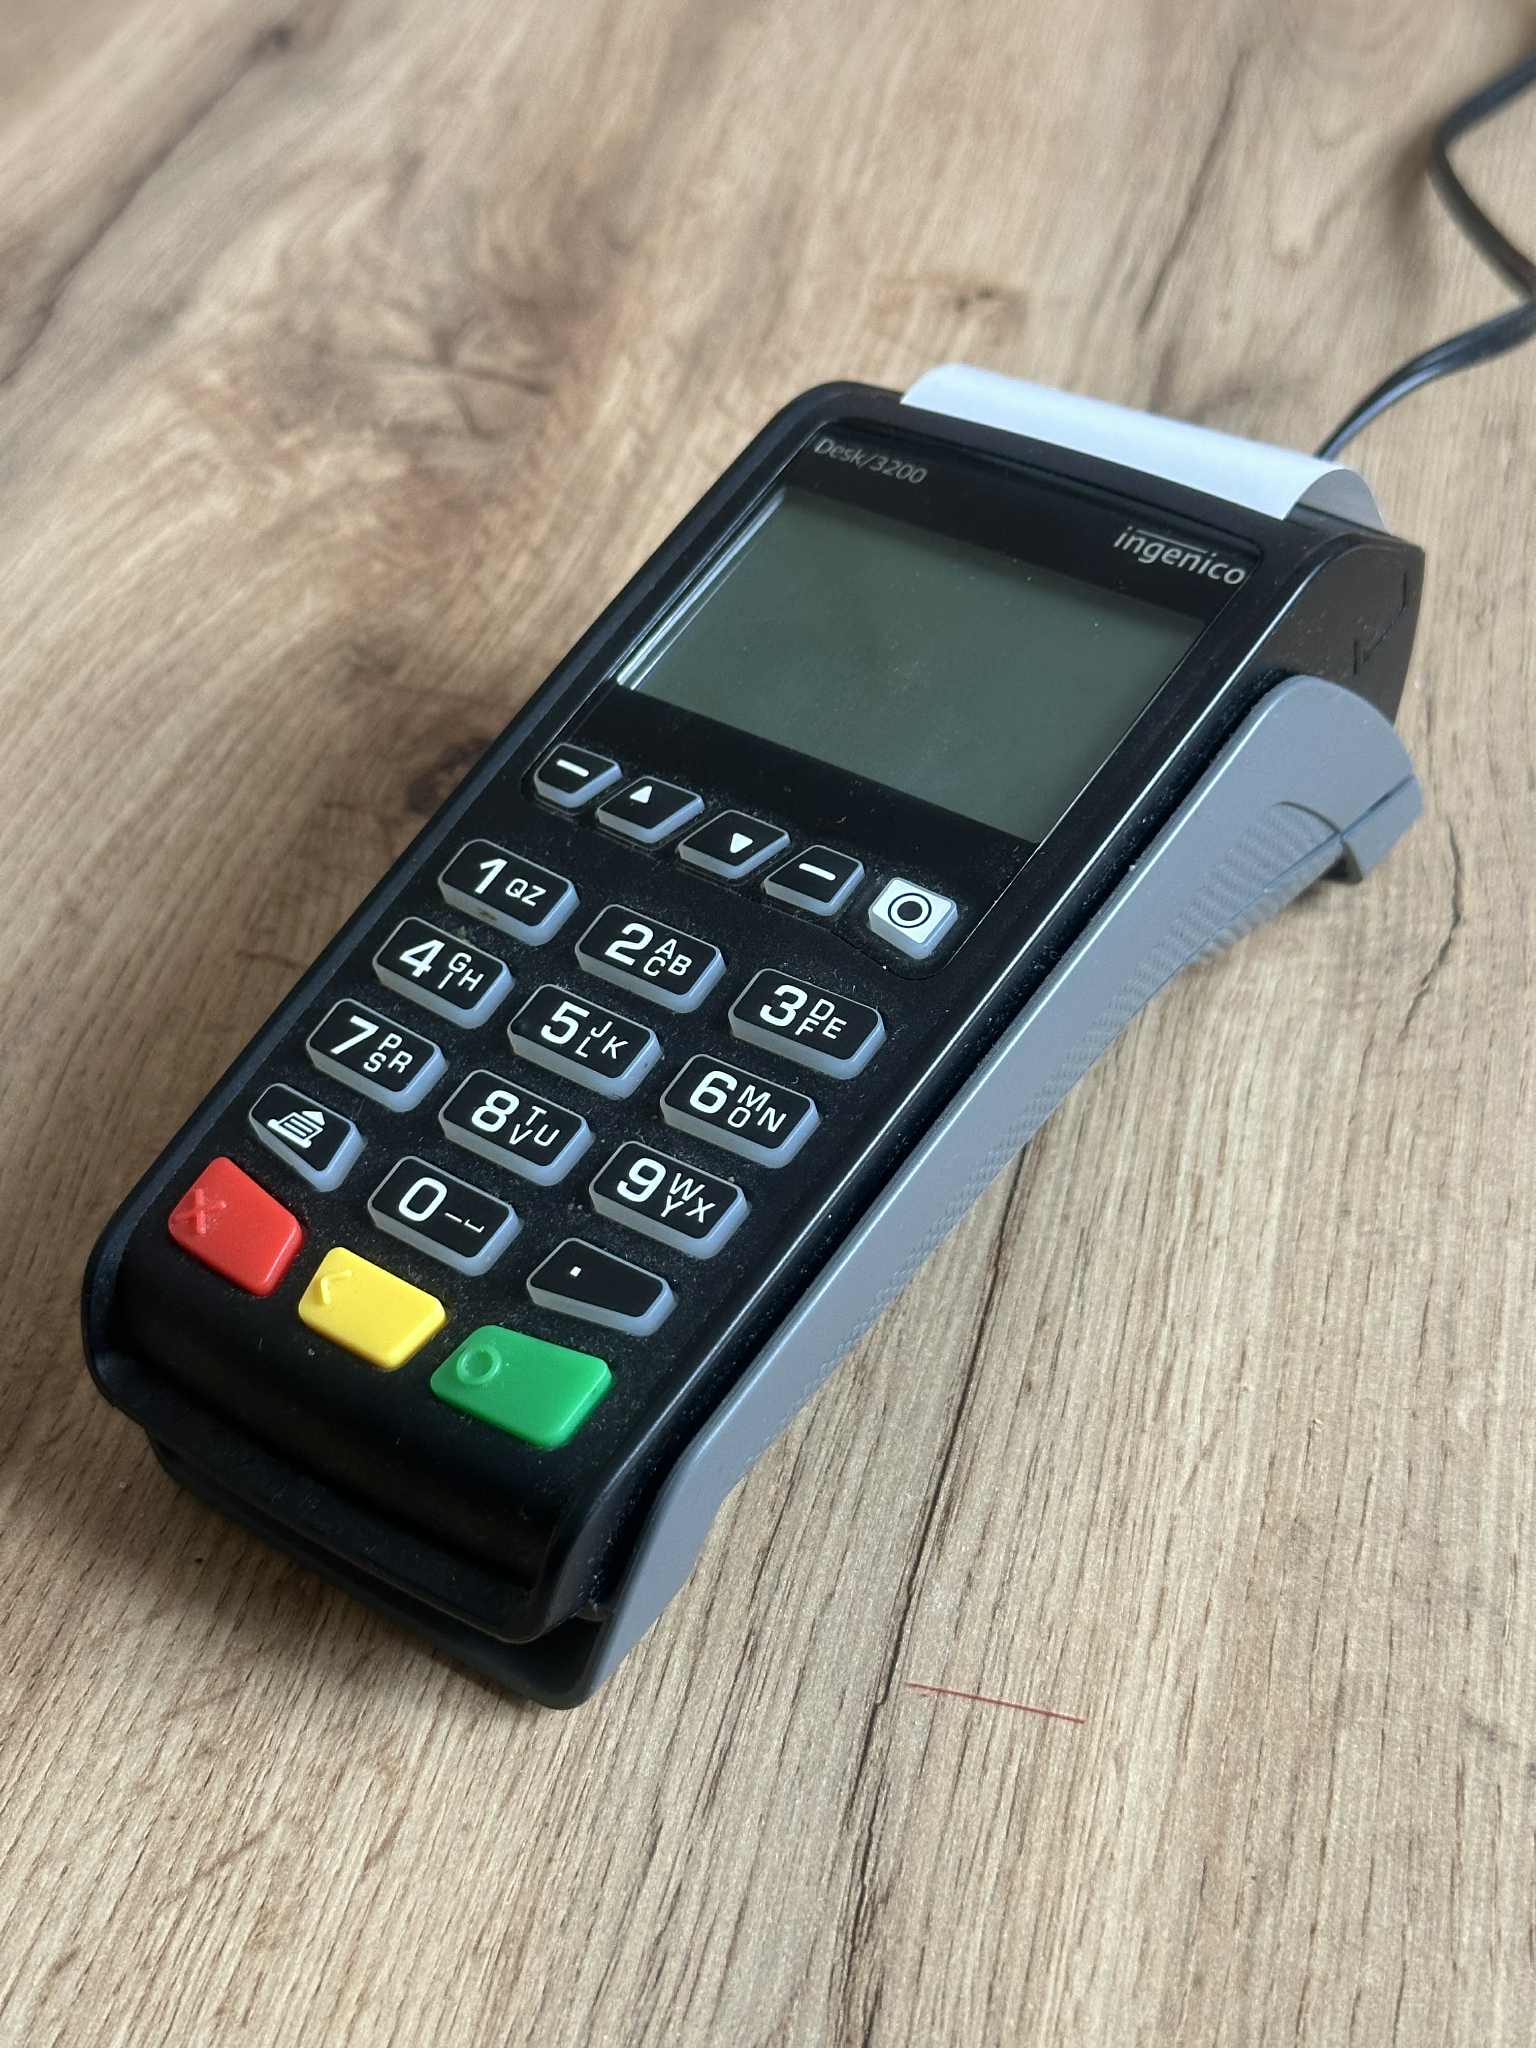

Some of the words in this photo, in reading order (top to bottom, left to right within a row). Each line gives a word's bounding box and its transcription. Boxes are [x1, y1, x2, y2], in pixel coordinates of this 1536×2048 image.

[814, 438, 928, 484] Desk/3200
[1114, 526, 1246, 586] ingenico
[474, 858, 508, 895] 1
[505, 878, 547, 907] QZ
[400, 939, 445, 978] 4
[604, 922, 654, 966] 2
[540, 1001, 590, 1045] 5
[759, 984, 808, 1027] 3
[330, 1015, 379, 1055] 7
[471, 1090, 520, 1133] 8
[690, 1070, 738, 1114] 6
[399, 1177, 447, 1222] 0
[617, 1158, 666, 1202] 9
